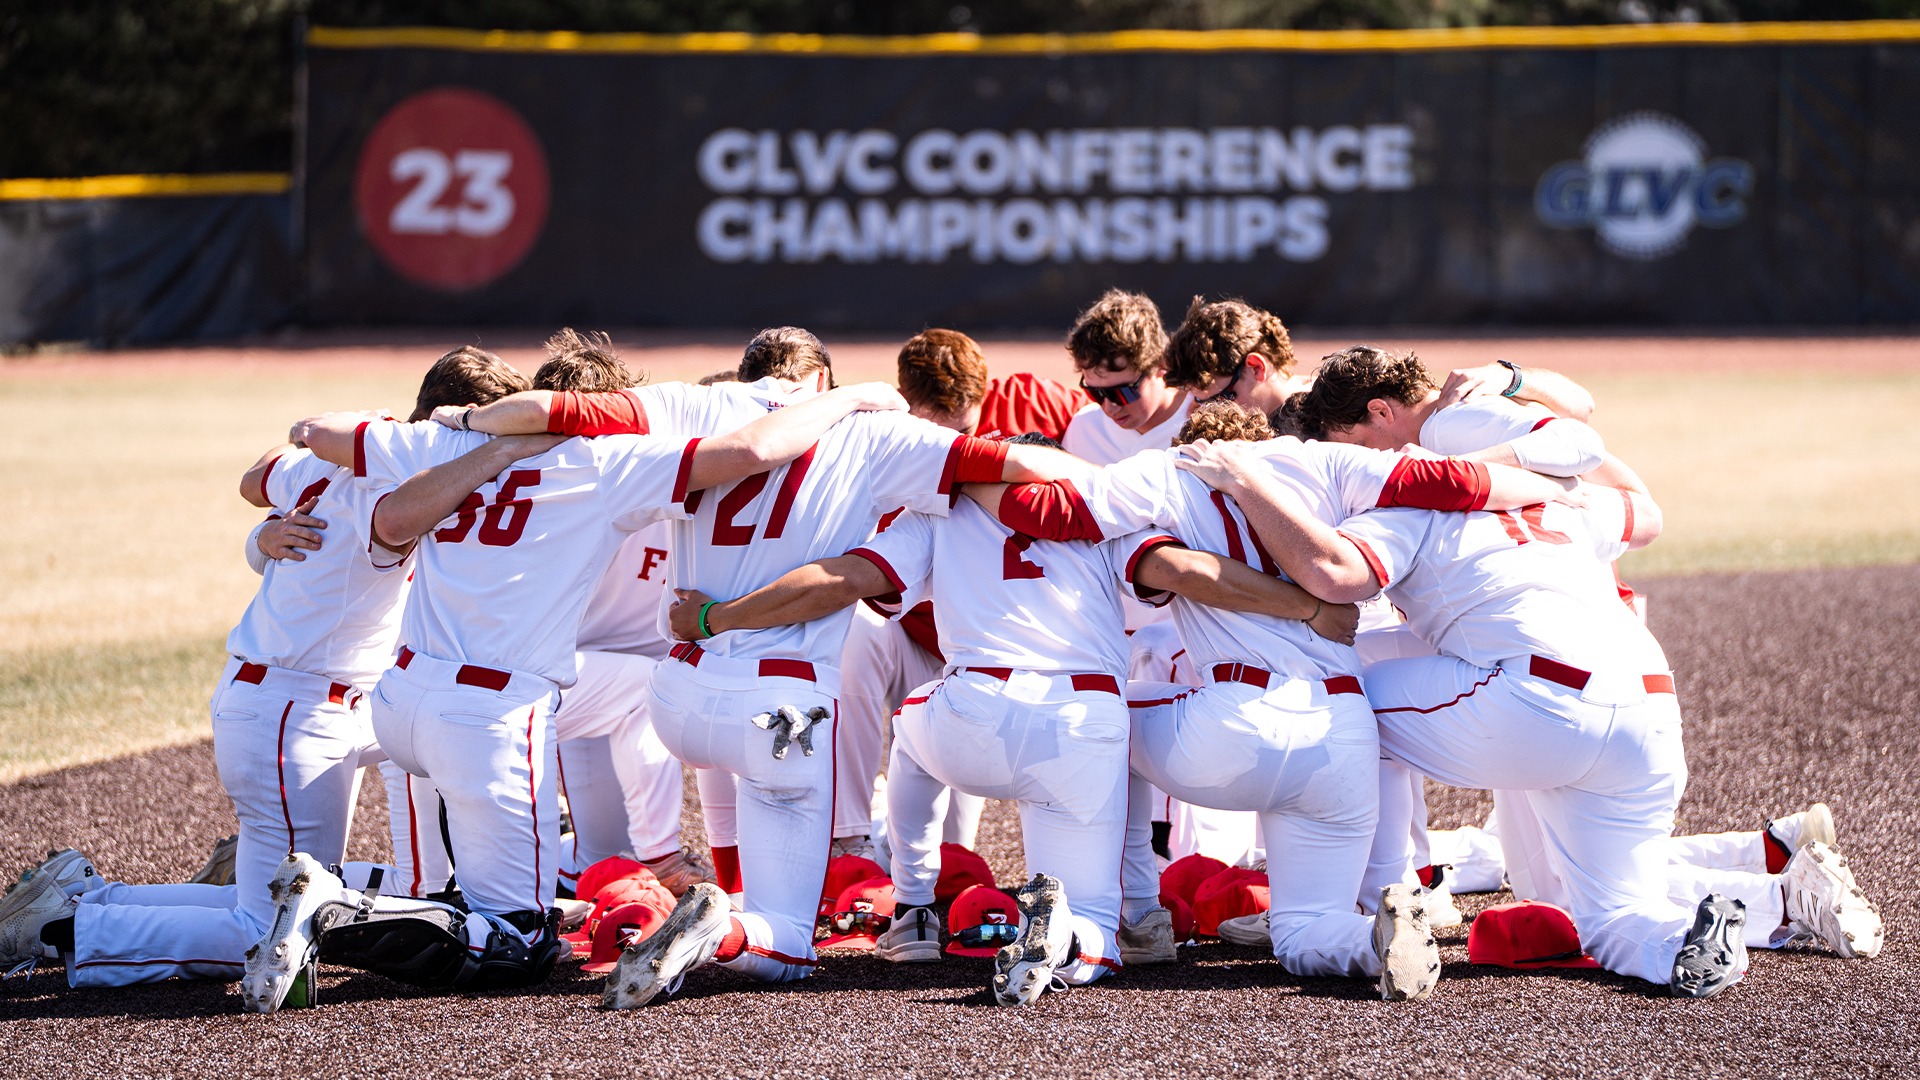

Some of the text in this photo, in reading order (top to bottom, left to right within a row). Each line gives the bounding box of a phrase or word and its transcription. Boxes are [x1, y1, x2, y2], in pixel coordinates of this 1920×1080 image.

[390, 149, 514, 236] 23
[699, 124, 1413, 195] GLVC CONFERENCE
[1535, 158, 1755, 230] GLVC
[699, 196, 1330, 263] CHAMPIONSHIPS
[711, 439, 819, 546] 21
[637, 546, 668, 585] F
